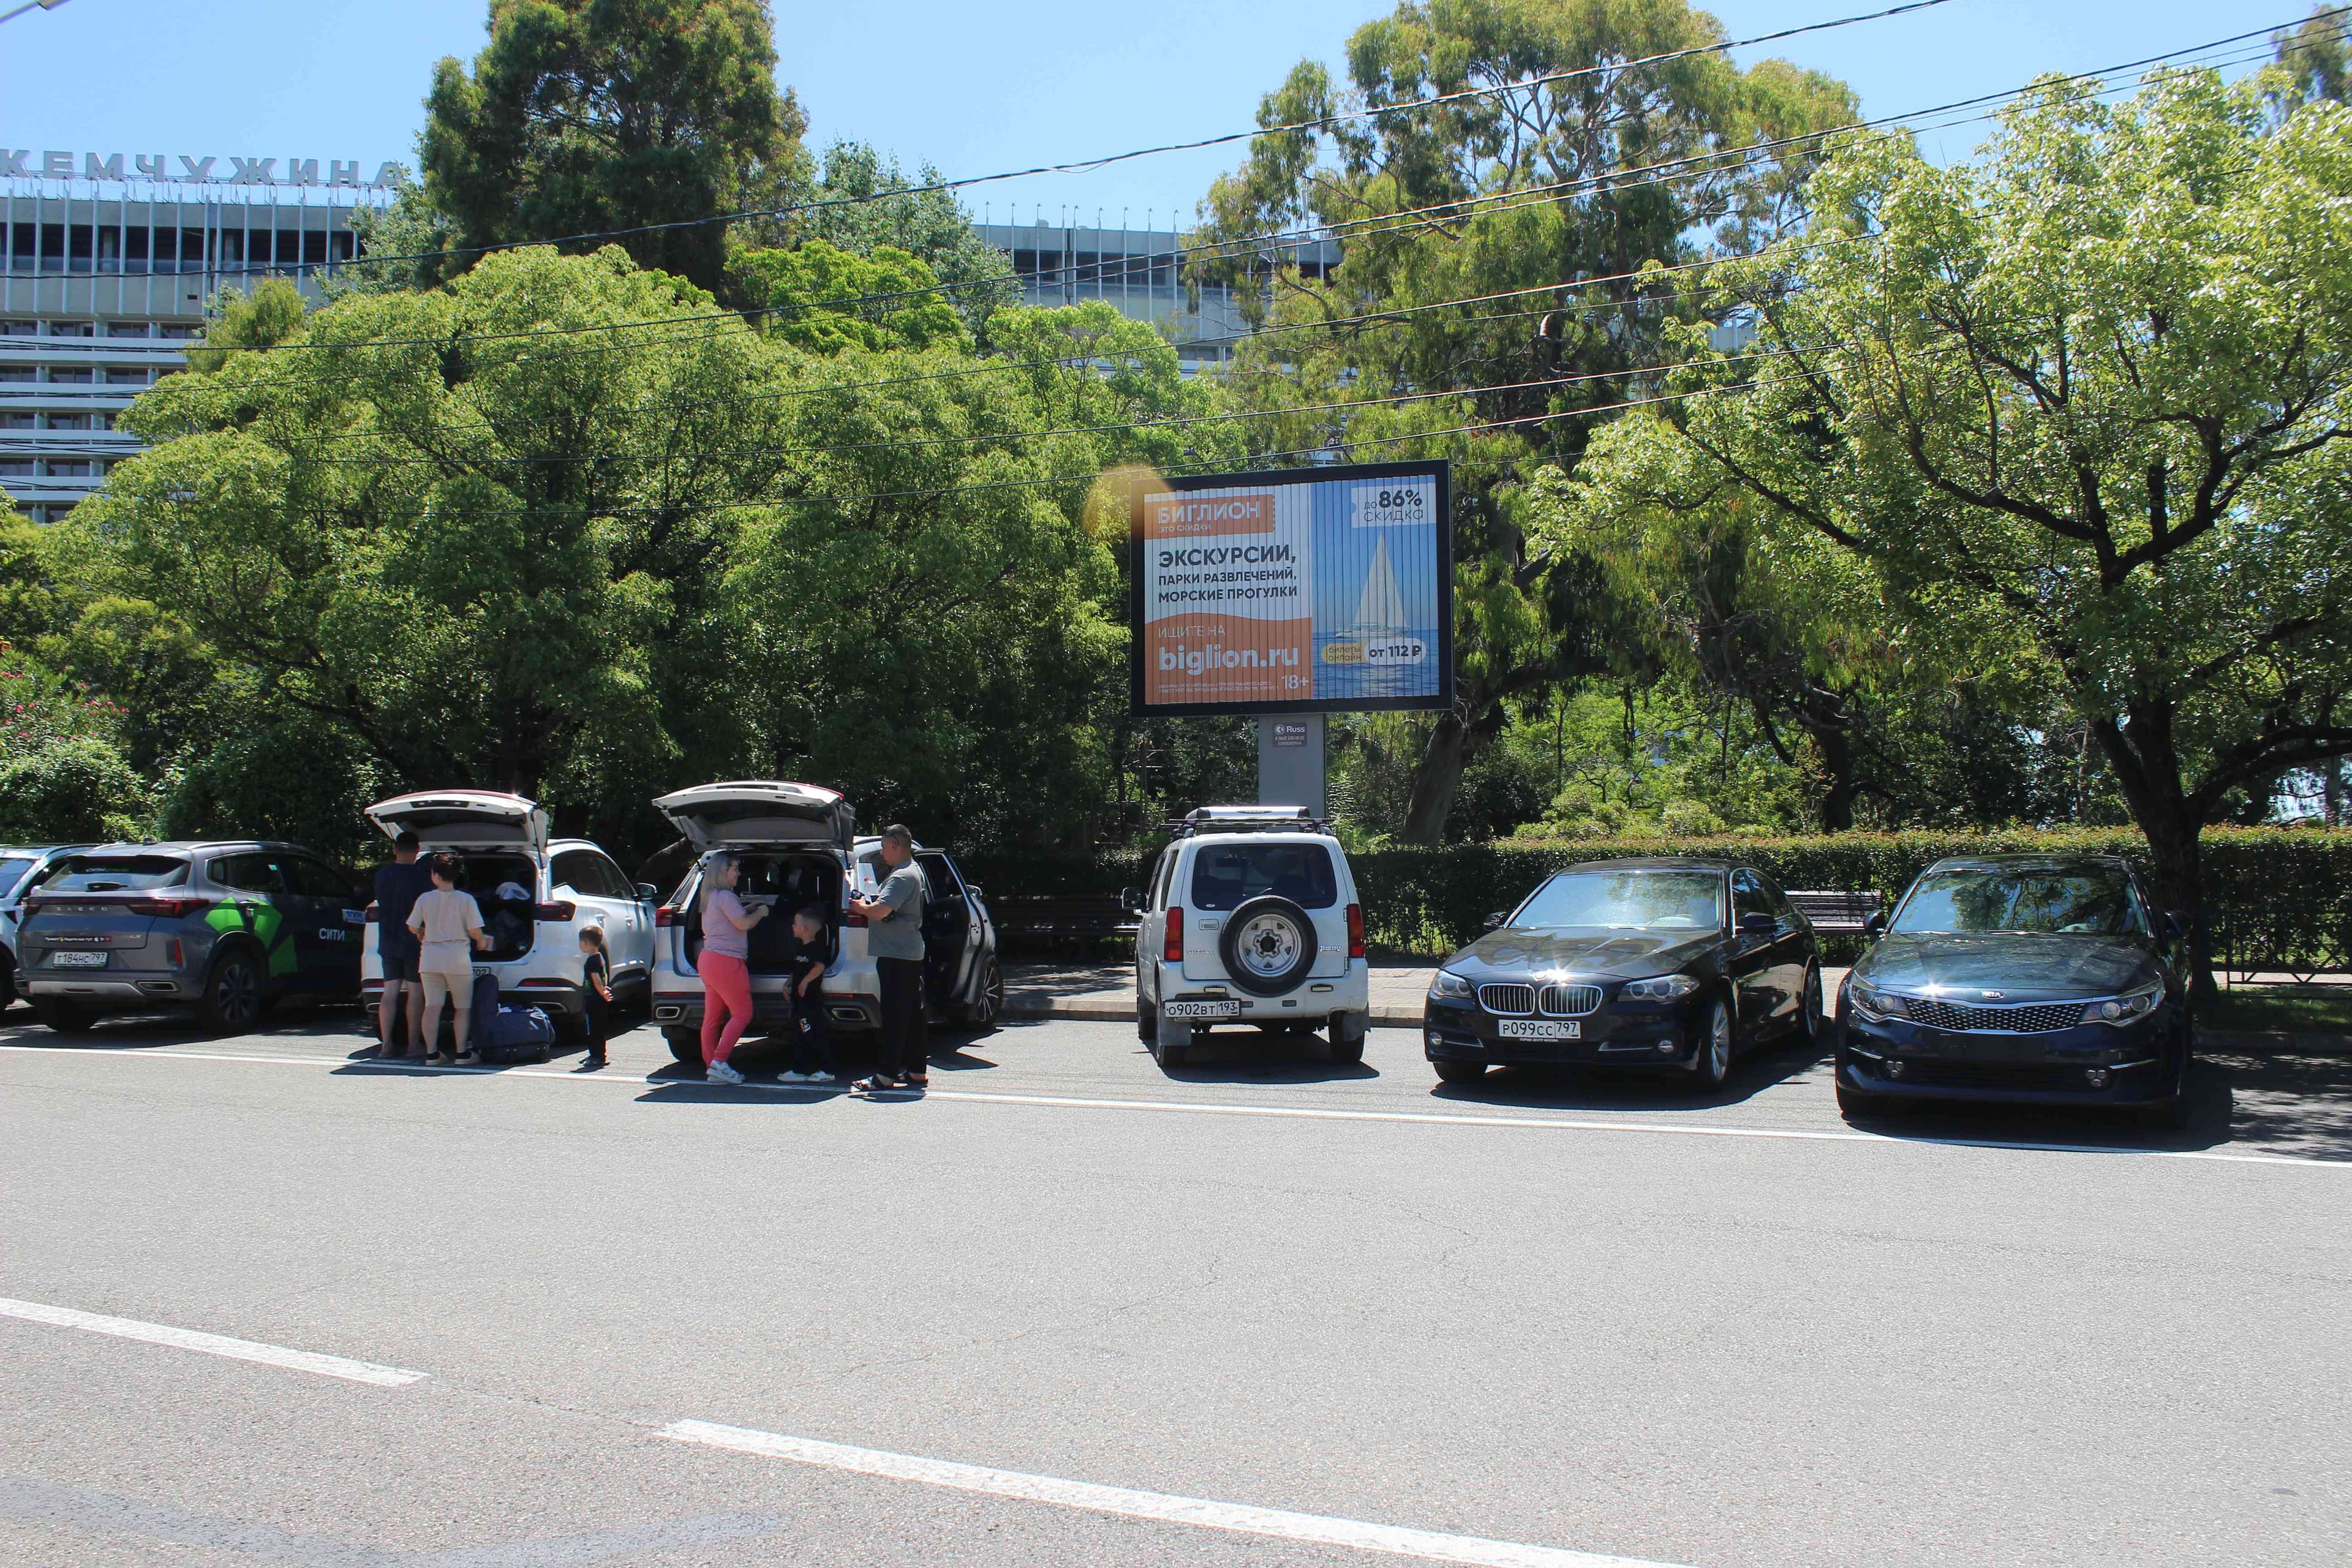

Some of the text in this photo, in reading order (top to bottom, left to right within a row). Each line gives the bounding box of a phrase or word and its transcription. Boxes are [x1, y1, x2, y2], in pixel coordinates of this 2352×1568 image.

[1379, 489, 1422, 508] 86%
[1158, 501, 1260, 524] БИГЛИОН
[1363, 509, 1423, 522] скидка
[1158, 545, 1296, 568] ЭКСКУРСИИ,
[1159, 567, 1297, 586] ПАРКИ РАЗВЛЕЧЕНИЙ,
[1159, 586, 1298, 603] МОРСКИЕ ПРОГУЛКИ
[1158, 625, 1226, 638] ИЩИТЕ НА
[1328, 653, 1362, 662] онлайн
[1369, 649, 1385, 658] от
[1388, 646, 1409, 657] 112
[1159, 644, 1298, 676] biglion.ru
[1281, 674, 1309, 690] 18+
[318, 928, 345, 941] СИТИ
[57, 954, 89, 963] Т184НС
[1169, 1002, 1236, 1016] О902ВТ 193
[1502, 1022, 1577, 1036] Р099СС 797
